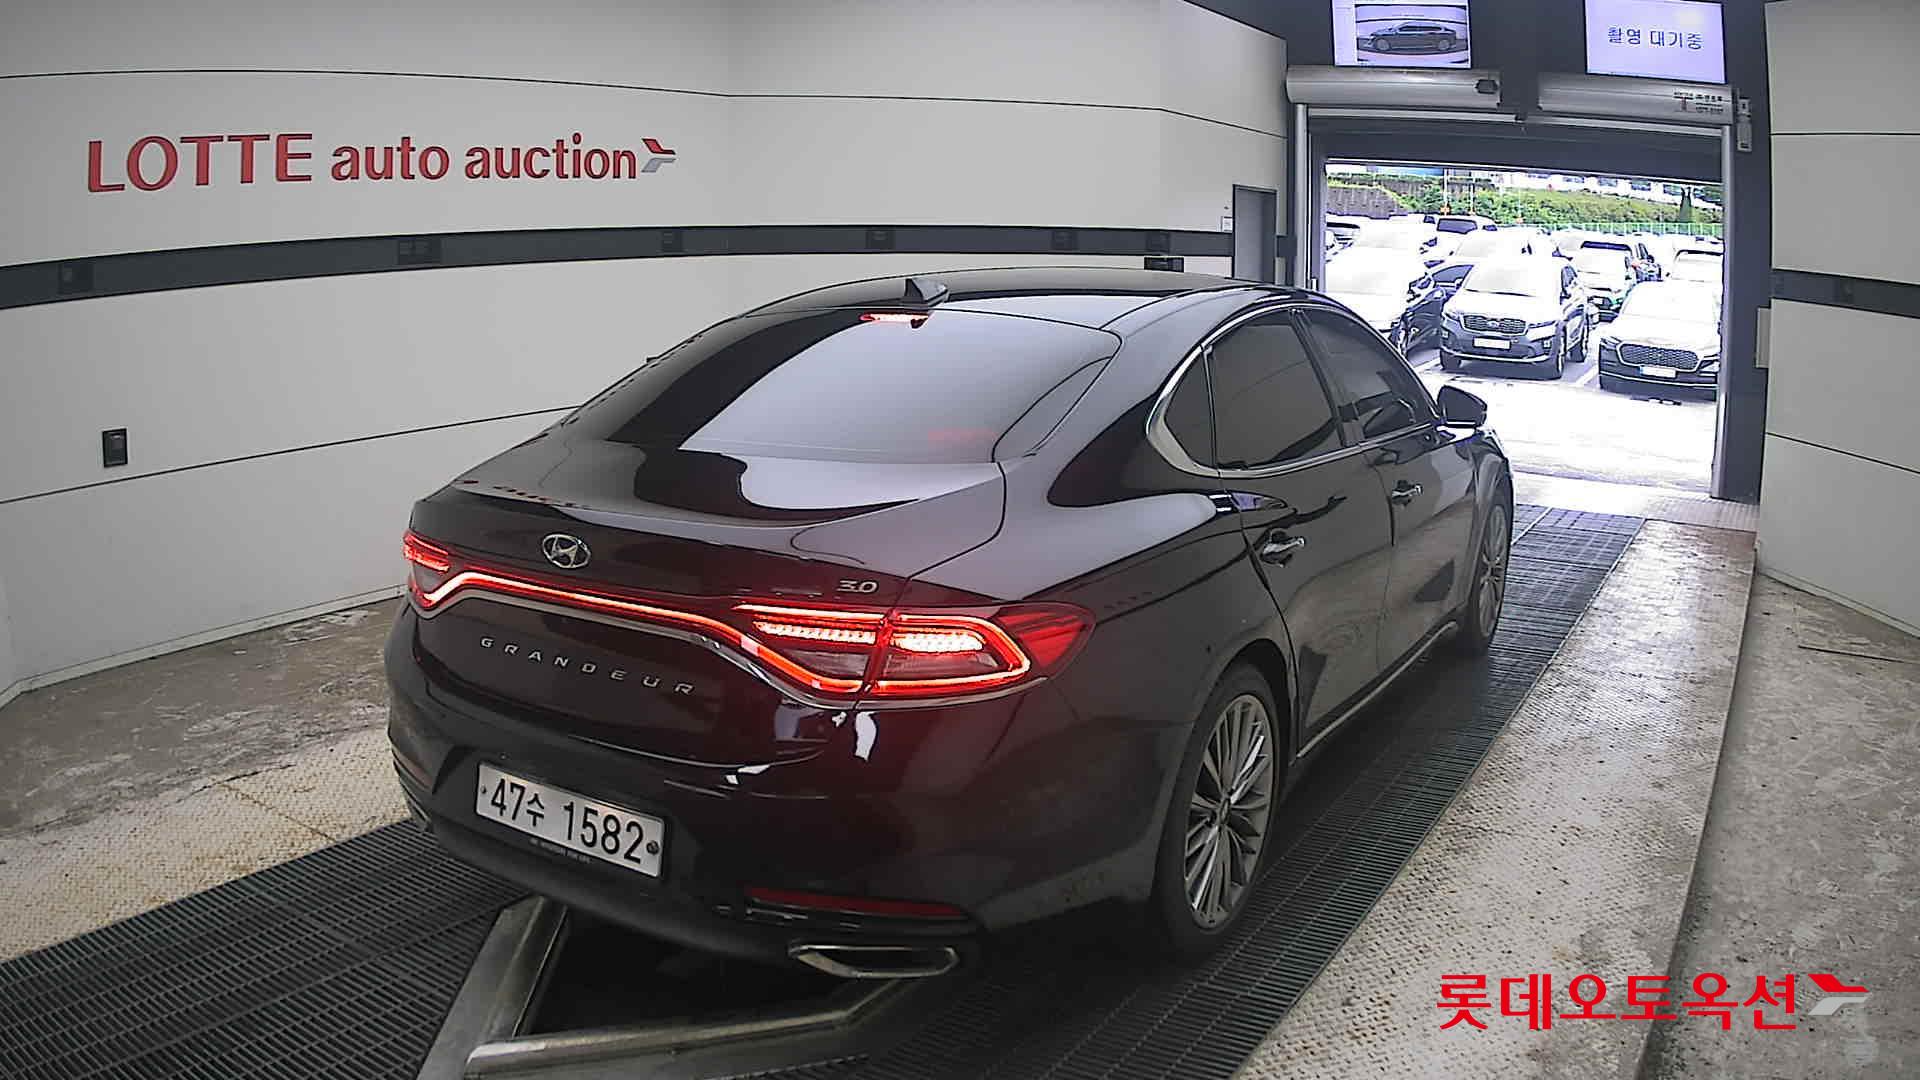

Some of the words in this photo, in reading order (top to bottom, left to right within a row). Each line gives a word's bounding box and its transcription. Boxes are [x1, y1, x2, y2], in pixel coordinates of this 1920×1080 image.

[1608, 27, 1641, 45] 촬영
[88, 133, 312, 192] LOTTE
[330, 137, 450, 181] auto
[464, 132, 637, 180] auction
[480, 636, 696, 696] GRANDEUR
[490, 778, 545, 827] 47수
[563, 800, 645, 865] 1582
